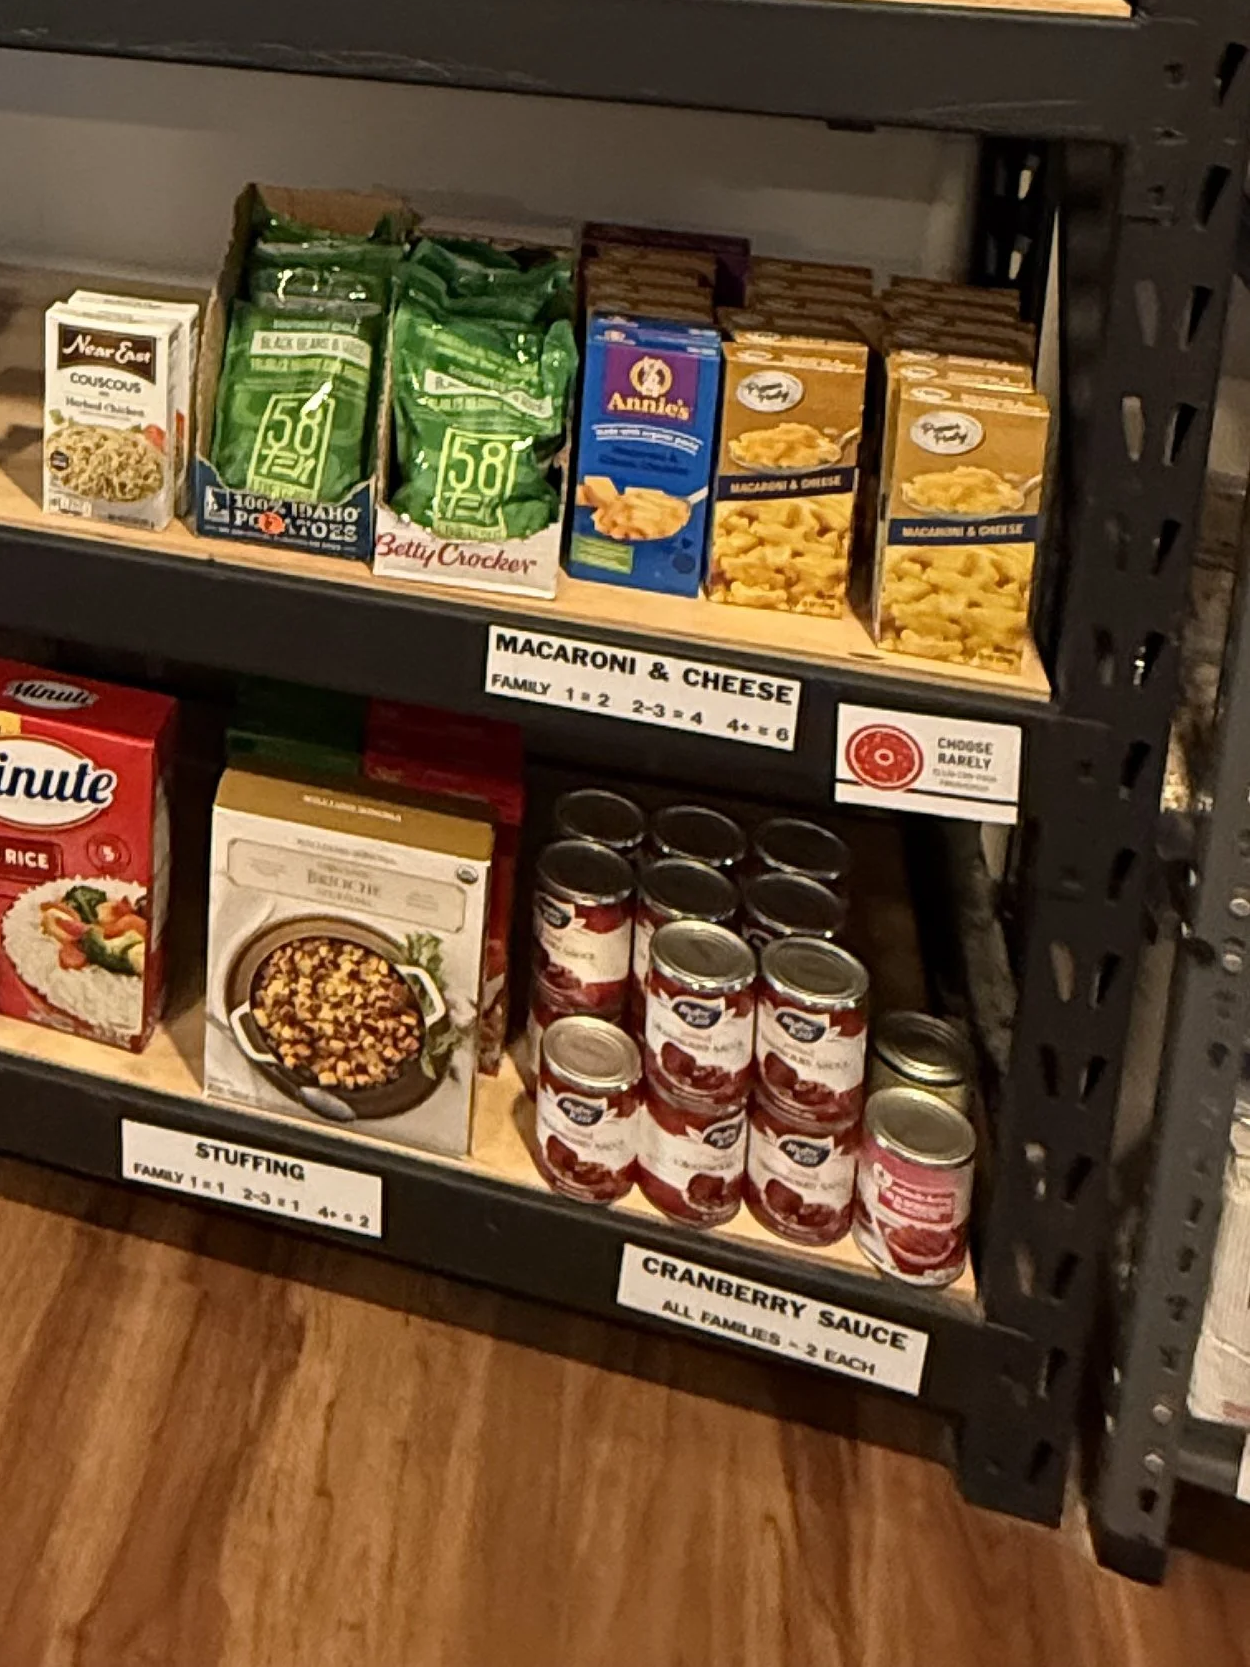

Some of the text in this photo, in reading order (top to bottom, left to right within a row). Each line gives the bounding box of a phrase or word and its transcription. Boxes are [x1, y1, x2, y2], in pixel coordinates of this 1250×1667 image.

[62, 333, 152, 365] Near East
[70, 371, 143, 395] COUSCOUS
[607, 391, 692, 422] Annie's
[266, 399, 323, 458] 58
[448, 434, 509, 497] 58
[234, 492, 355, 524] 100% IDAHO
[234, 508, 358, 544] POATOES
[376, 532, 538, 575] Betty Crocker
[496, 633, 794, 706] MACARONI & CHEESE
[491, 674, 551, 696] FAMILY
[565, 687, 574, 702] 1
[597, 693, 611, 708] 2
[632, 700, 666, 718] 2-3
[690, 711, 703, 726] 4
[726, 718, 749, 733] 4+
[937, 737, 995, 756] CHOOSE
[937, 753, 992, 771] RARELY
[4, 848, 50, 870] RICE
[195, 1141, 306, 1182] STUFFING
[133, 1161, 184, 1184] FAMILY
[243, 1187, 271, 1206] 2-3
[359, 1215, 370, 1228] 2
[641, 1255, 910, 1352] CRANBERRY SAUCE
[662, 1299, 877, 1376] ALL FAMILIES 2 EACH
